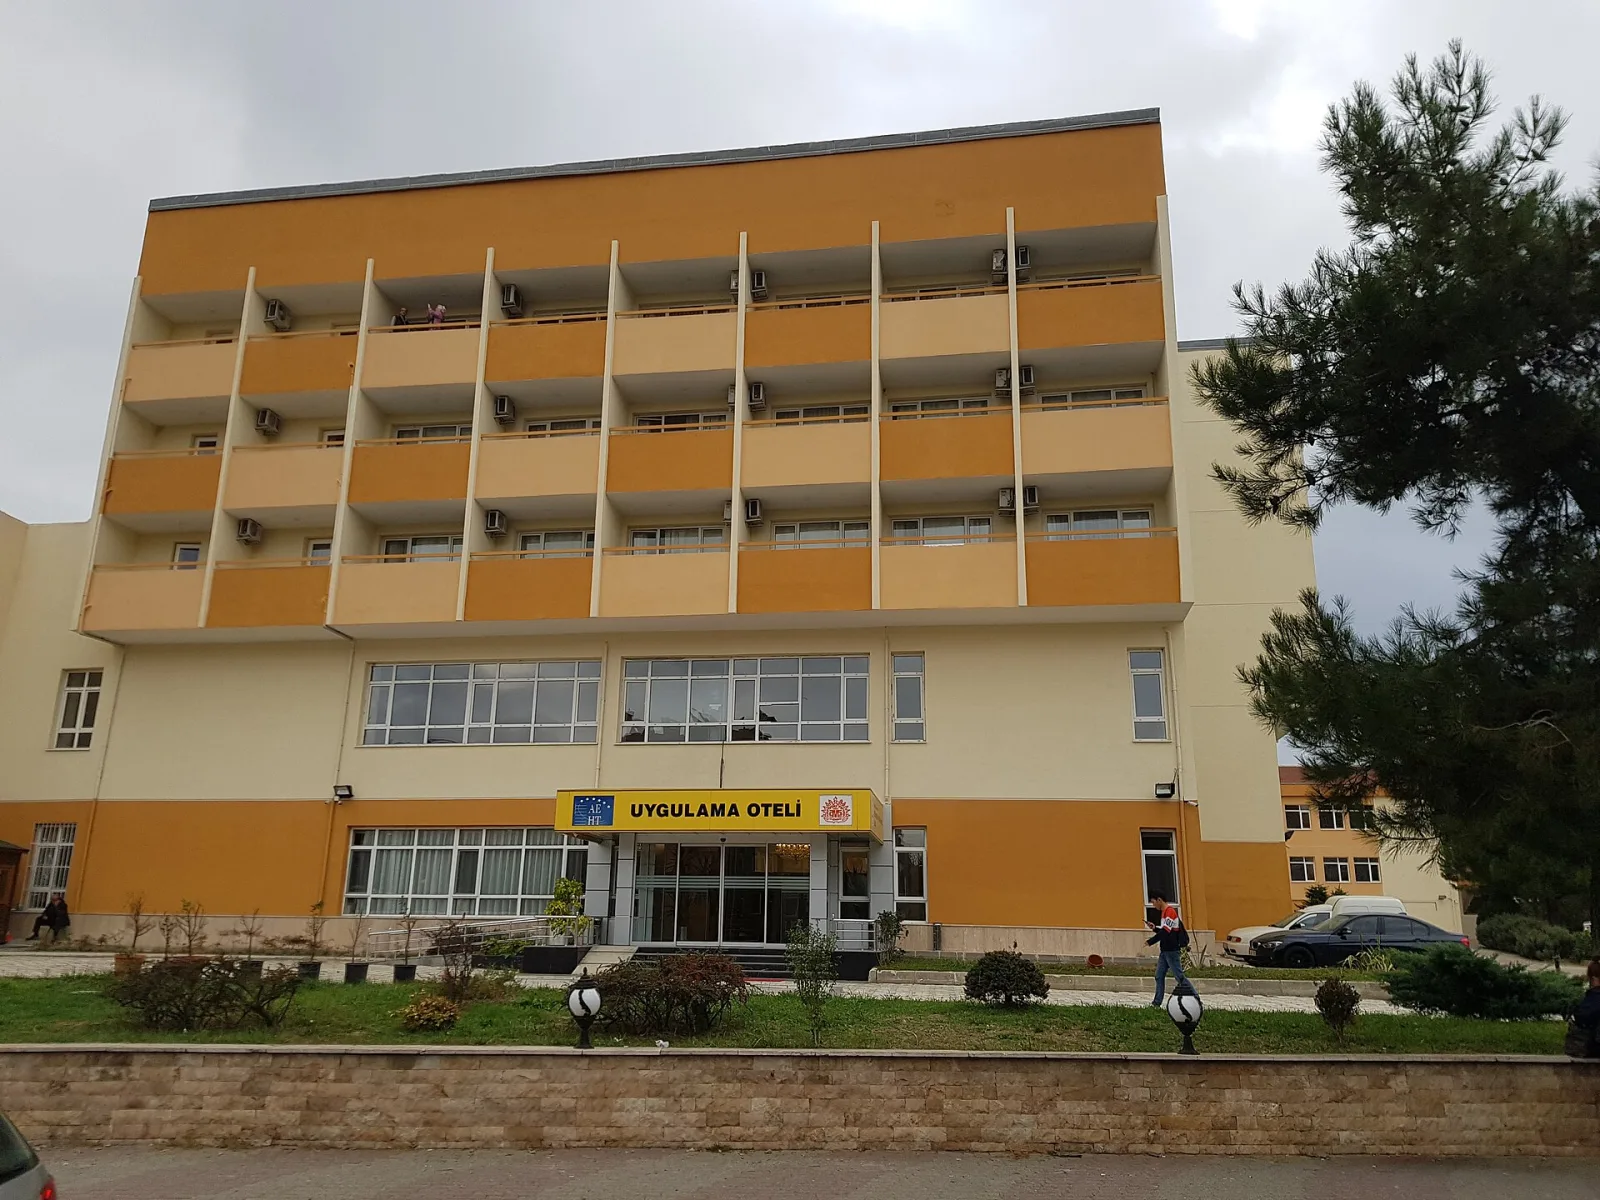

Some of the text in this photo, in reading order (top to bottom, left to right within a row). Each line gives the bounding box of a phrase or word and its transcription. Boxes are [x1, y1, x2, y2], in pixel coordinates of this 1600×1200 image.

[588, 803, 602, 814] AE
[630, 799, 802, 818] UYGULAMA OTELİ
[587, 815, 602, 826] HT
